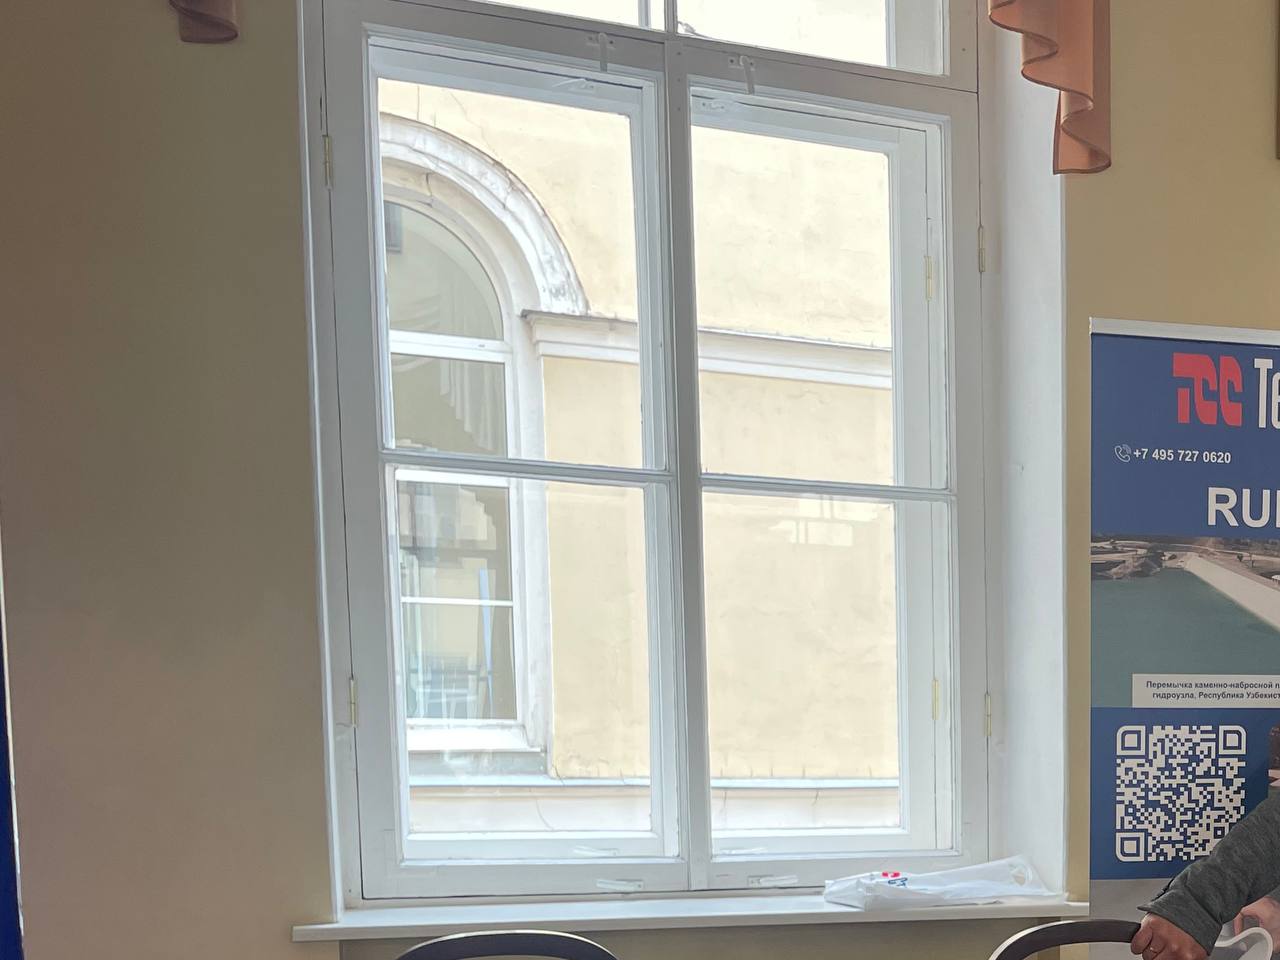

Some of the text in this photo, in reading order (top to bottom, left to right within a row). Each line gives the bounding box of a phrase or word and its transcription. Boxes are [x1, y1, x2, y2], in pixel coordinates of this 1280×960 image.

[1133, 448, 1231, 463] +7 495 727 0620
[1146, 681, 1193, 690] Перемычка
[1194, 681, 1273, 690] каменно-набросной
[1152, 692, 1196, 700] гидроузла,
[1198, 691, 1244, 701] Республика
